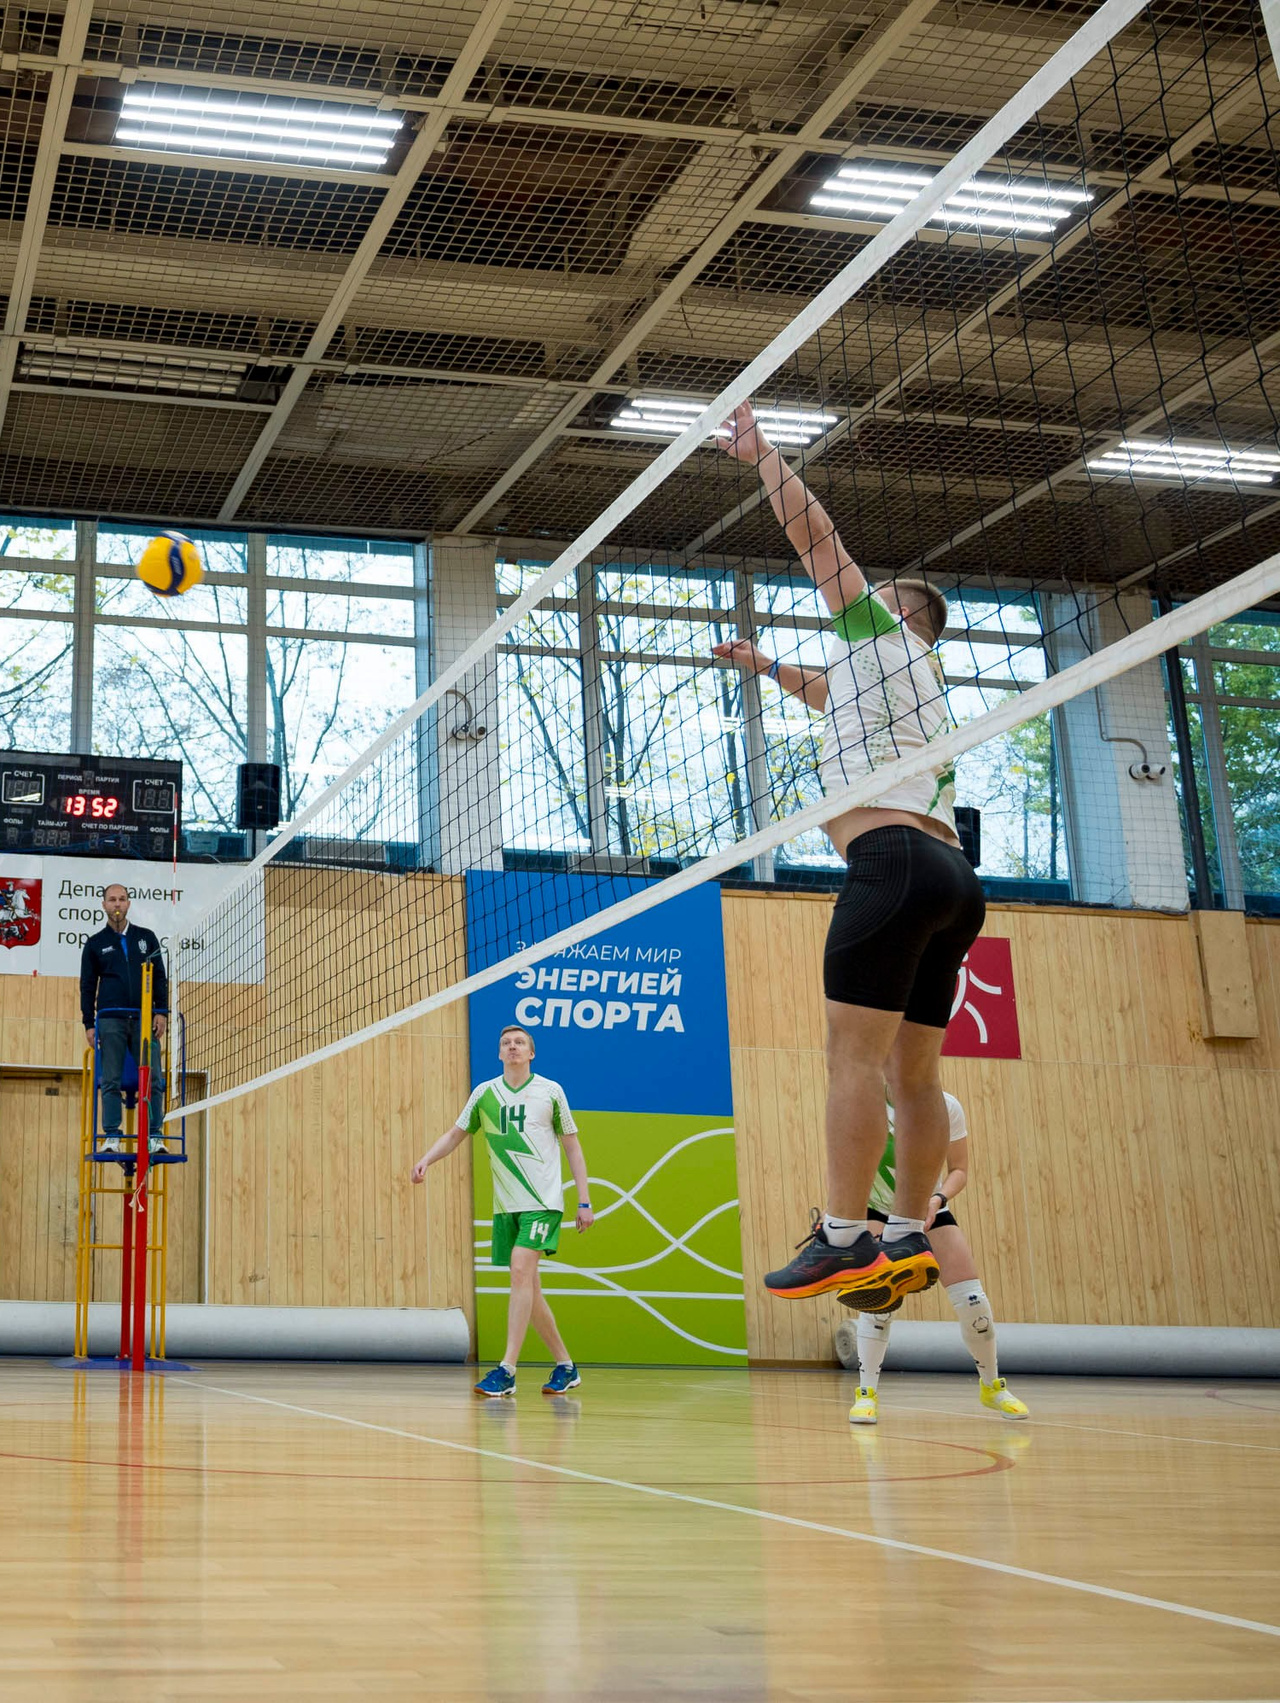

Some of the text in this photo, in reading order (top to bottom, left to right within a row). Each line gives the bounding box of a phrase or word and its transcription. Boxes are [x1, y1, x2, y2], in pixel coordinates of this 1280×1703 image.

[13, 770, 34, 778] СЧЕТ
[57, 774, 83, 782] ПЕРИОД
[65, 796, 118, 818] 13 52
[3, 817, 24, 825] ФОЛЫ
[37, 819, 69, 827] ТАЙМ-АУТ
[149, 826, 170, 834] ФОЛЫ
[58, 879, 184, 902] Депаамент
[58, 907, 105, 926] спор
[635, 946, 682, 963] МИР
[515, 966, 683, 997] ЭНЕРГИЕЙ
[515, 996, 685, 1033] СПОРТА
[500, 1103, 527, 1135] 14
[529, 1220, 550, 1244] 14
